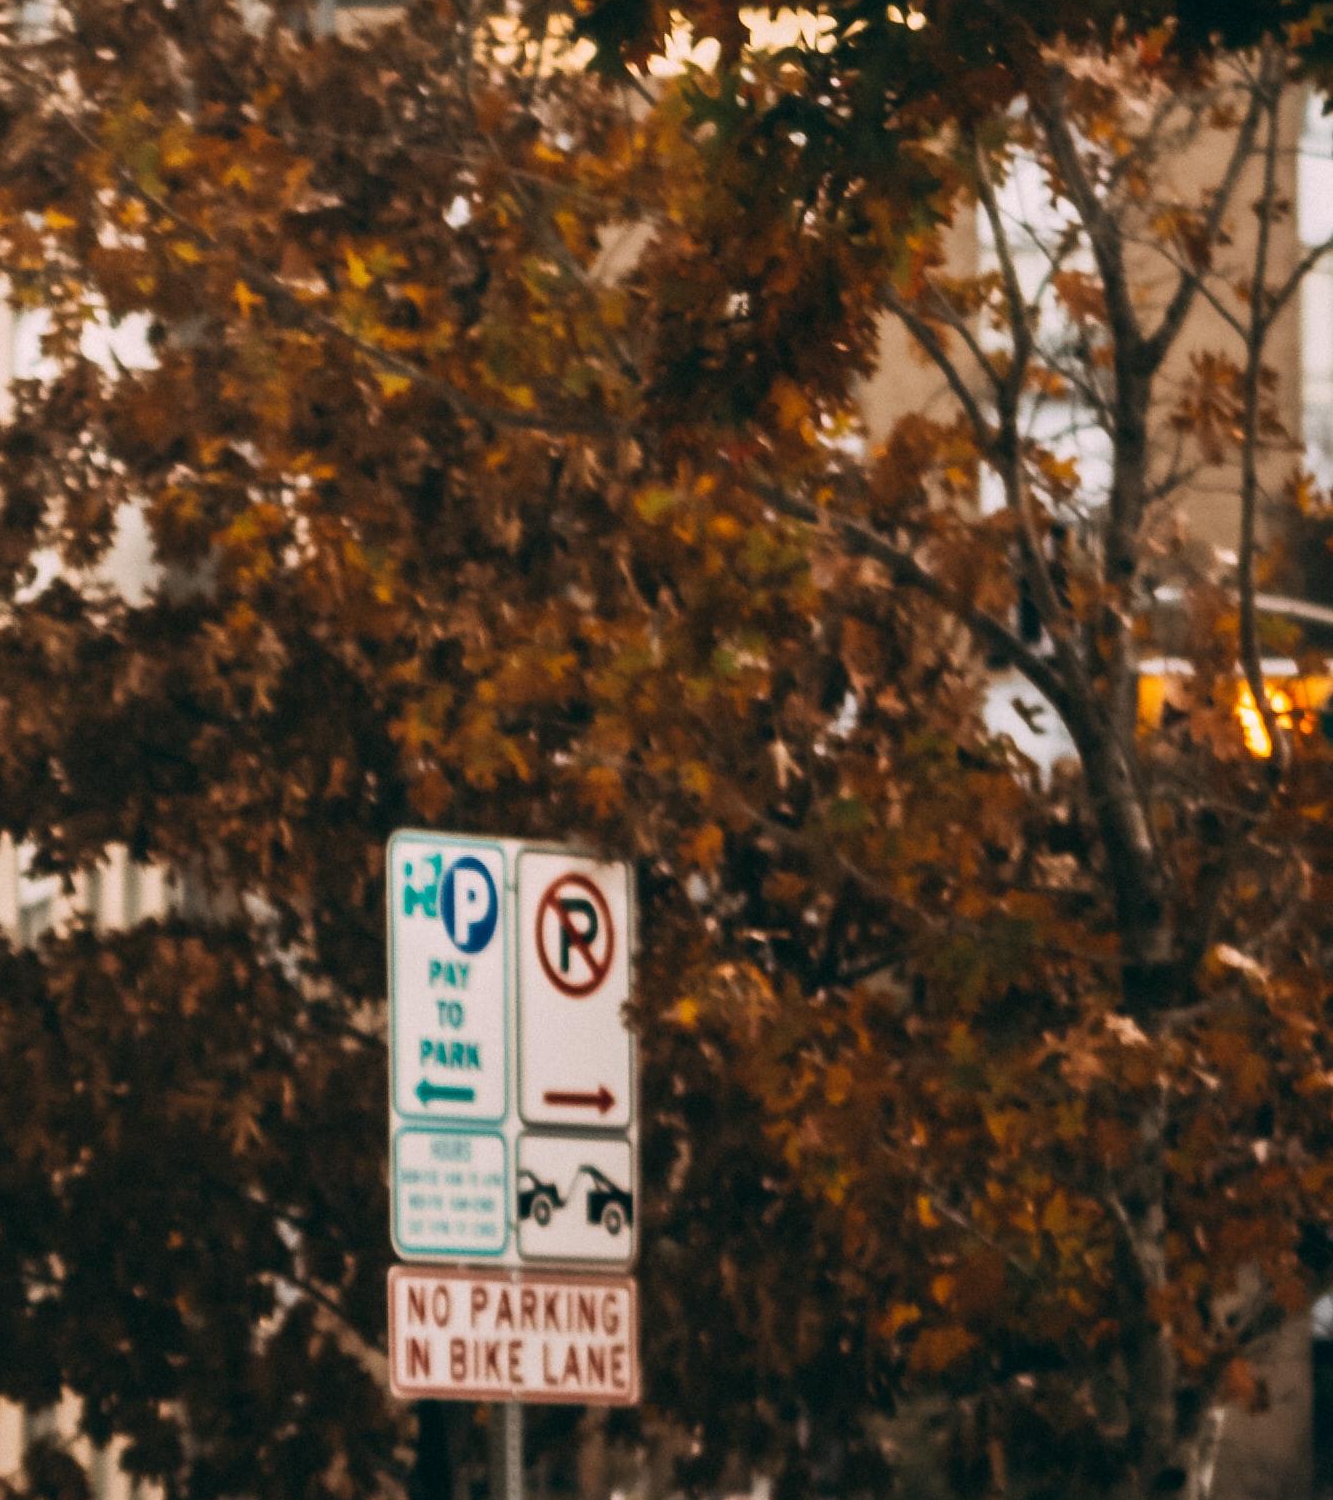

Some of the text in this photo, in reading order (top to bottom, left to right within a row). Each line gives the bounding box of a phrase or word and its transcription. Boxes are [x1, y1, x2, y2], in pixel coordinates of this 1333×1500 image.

[454, 868, 490, 945] P
[429, 961, 469, 989] PAY
[437, 1000, 464, 1028] TO
[420, 1039, 480, 1070] PARK
[408, 1283, 620, 1336] NO PARKING
[406, 1336, 626, 1388] IN BIKE LANE
